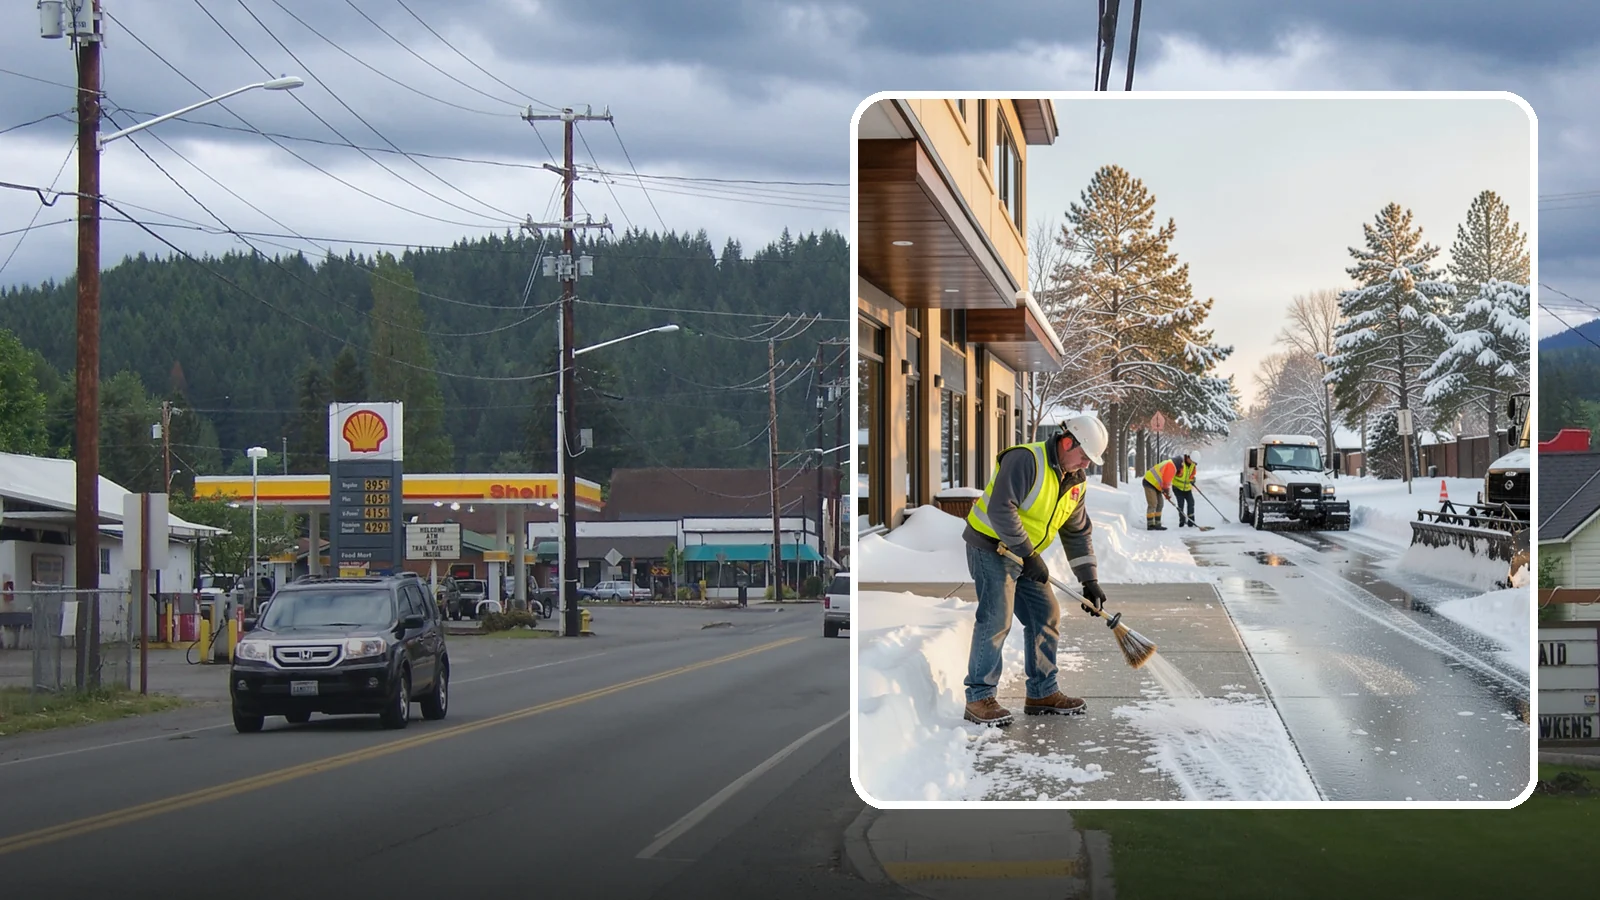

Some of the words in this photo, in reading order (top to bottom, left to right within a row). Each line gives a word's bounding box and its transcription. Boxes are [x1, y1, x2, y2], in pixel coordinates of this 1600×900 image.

[365, 480, 384, 490] 395
[490, 484, 547, 499] Shell
[365, 494, 384, 504] 405
[365, 508, 384, 518] 415
[365, 522, 384, 532] 429
